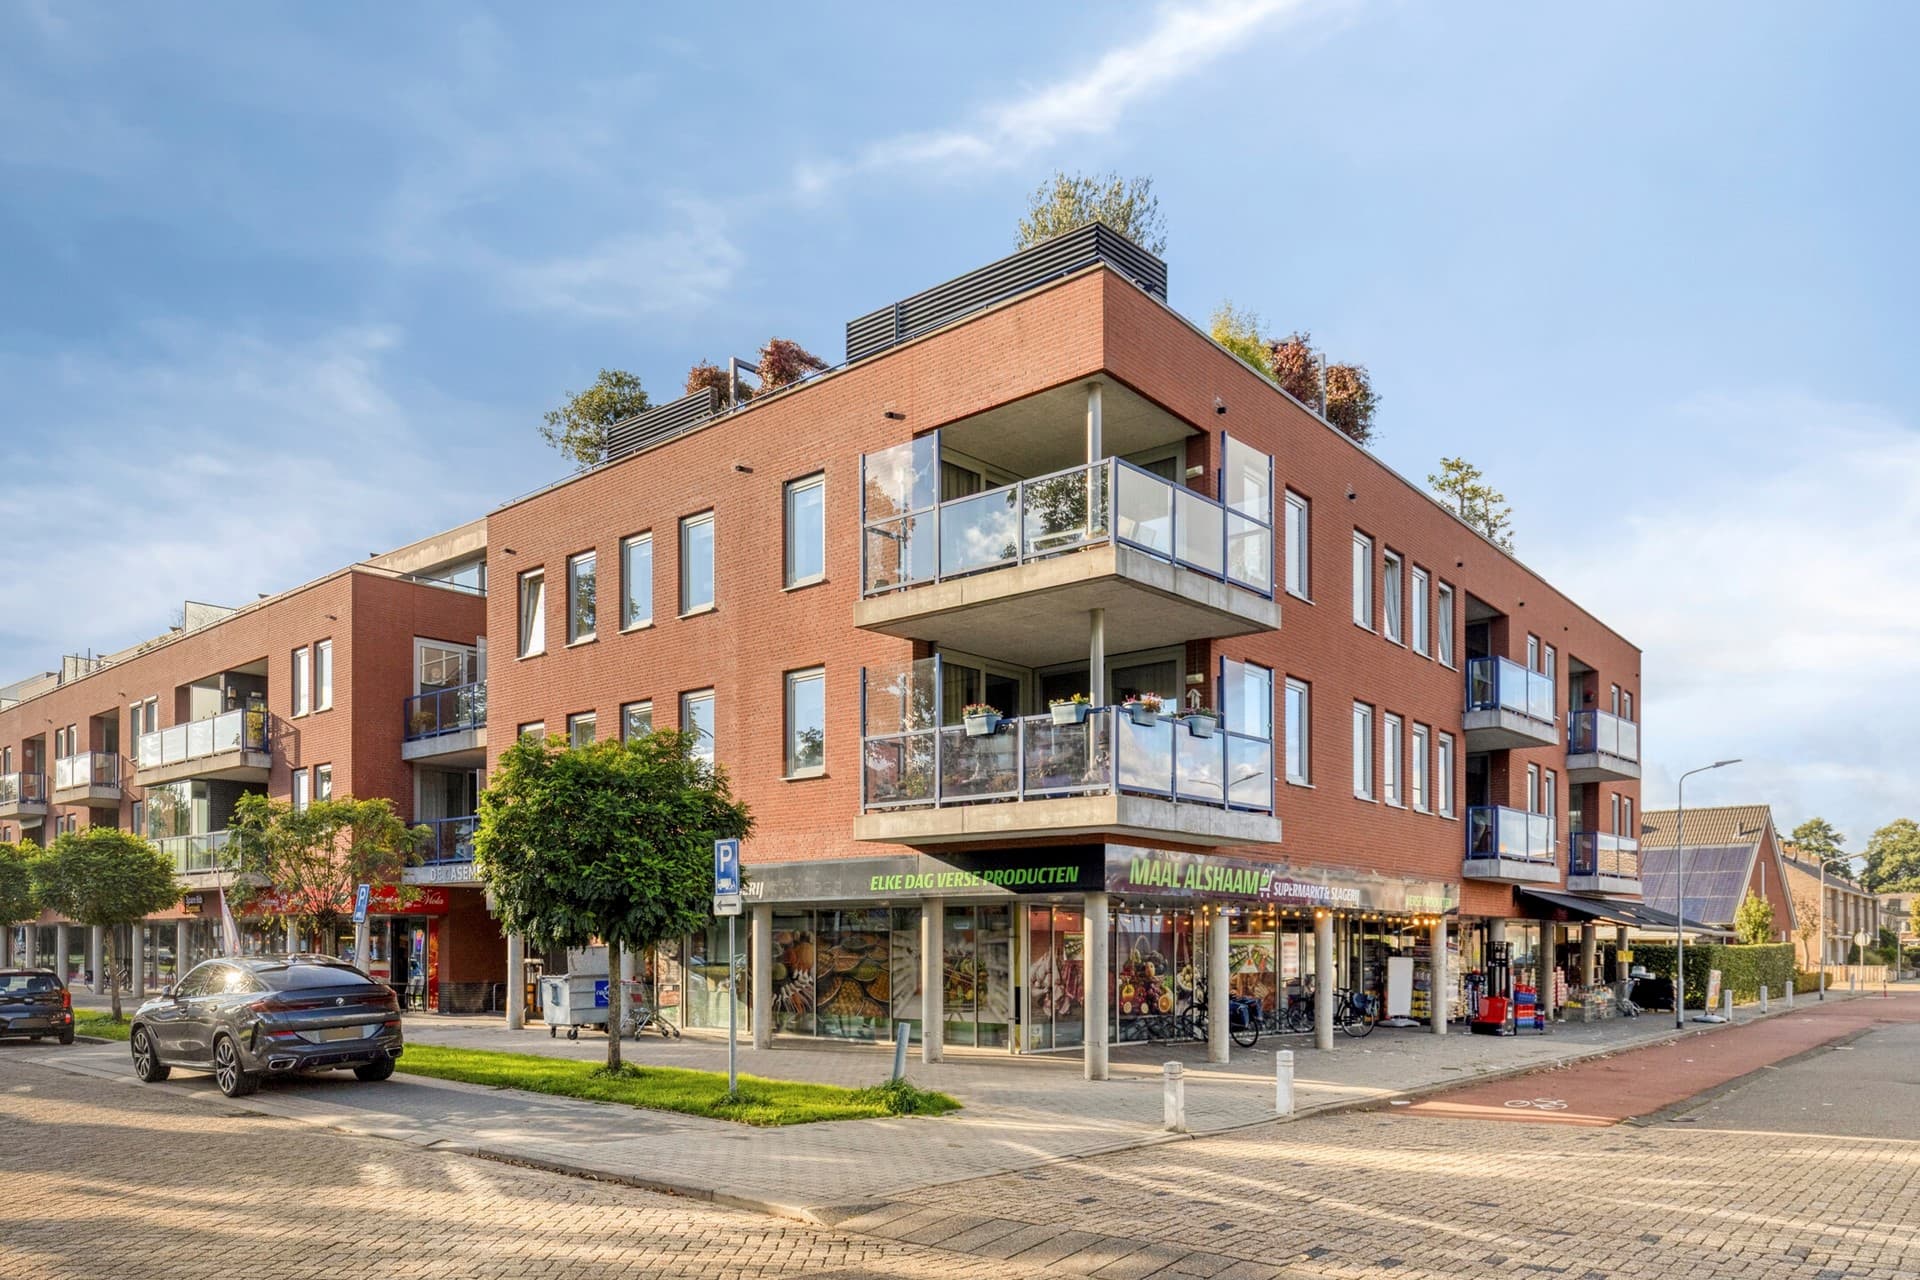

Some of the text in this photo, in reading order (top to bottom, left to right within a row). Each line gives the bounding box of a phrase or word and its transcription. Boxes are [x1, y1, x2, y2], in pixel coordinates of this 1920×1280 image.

[720, 845, 732, 873] P
[870, 866, 1080, 891] ELKE DAG VERSE PRODUCTEN
[1129, 857, 1260, 895] MAAL ALSHAAM
[739, 881, 764, 899] ERIJ
